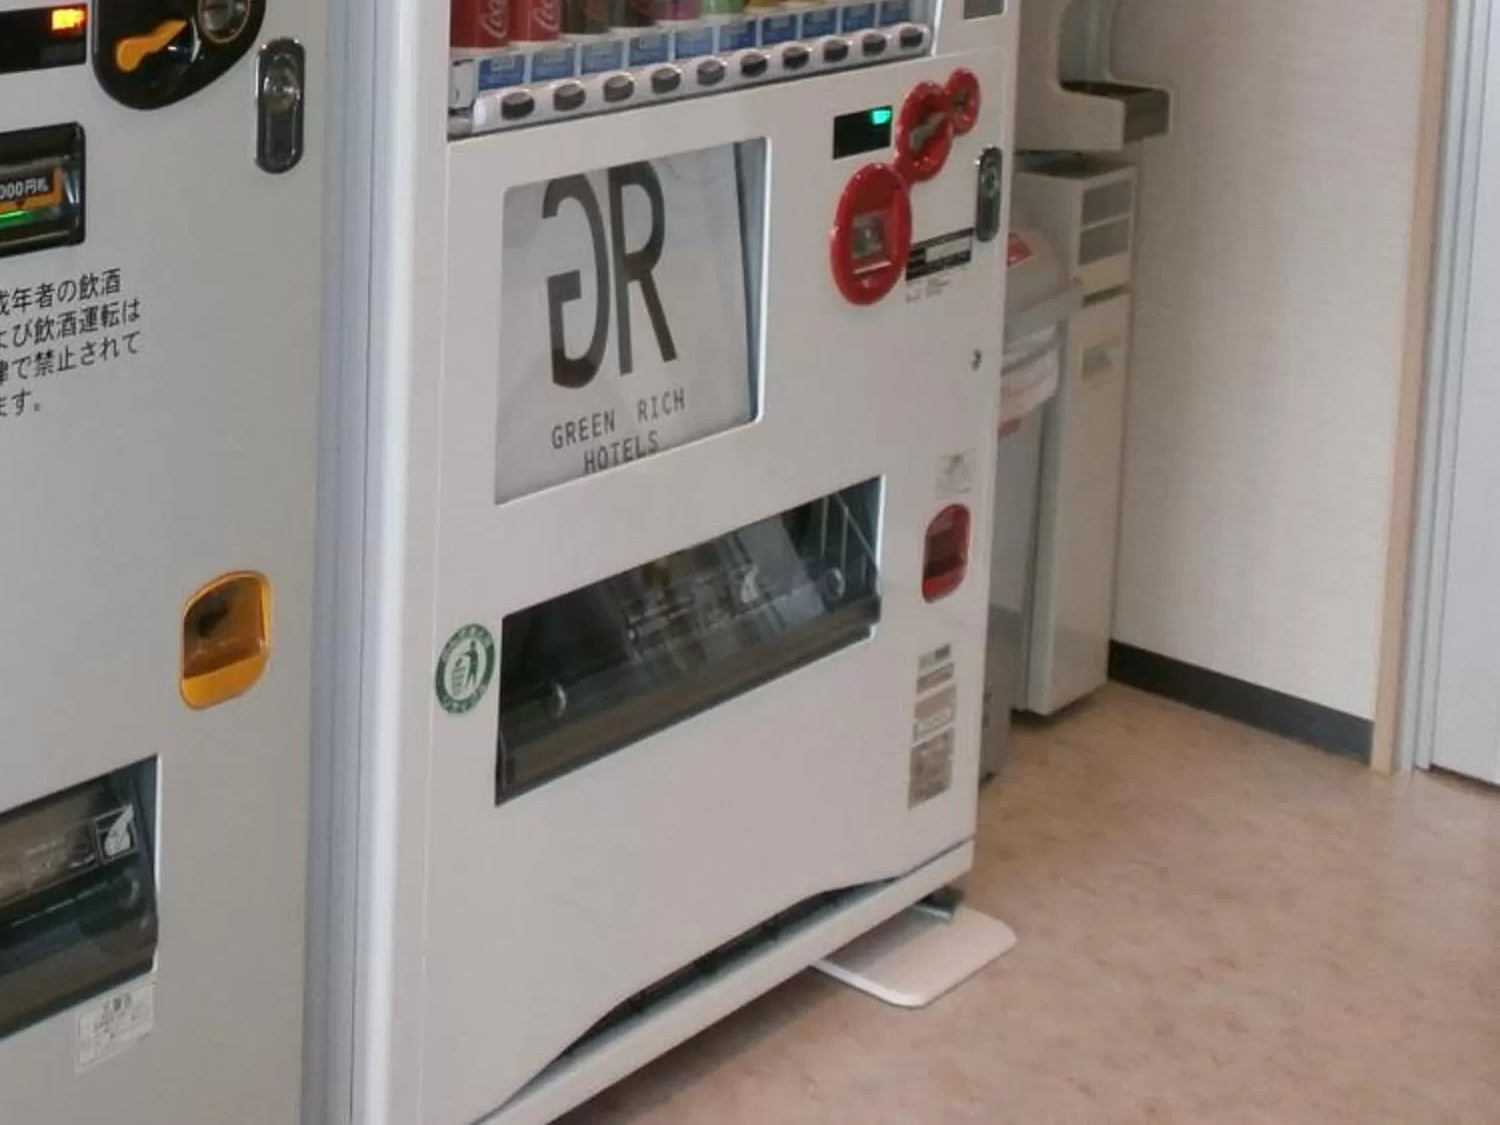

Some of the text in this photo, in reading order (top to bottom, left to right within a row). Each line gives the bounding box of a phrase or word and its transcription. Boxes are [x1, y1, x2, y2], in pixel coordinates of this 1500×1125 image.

[551, 387, 686, 450] GREEN RICH
[584, 431, 660, 475] HOTELS
